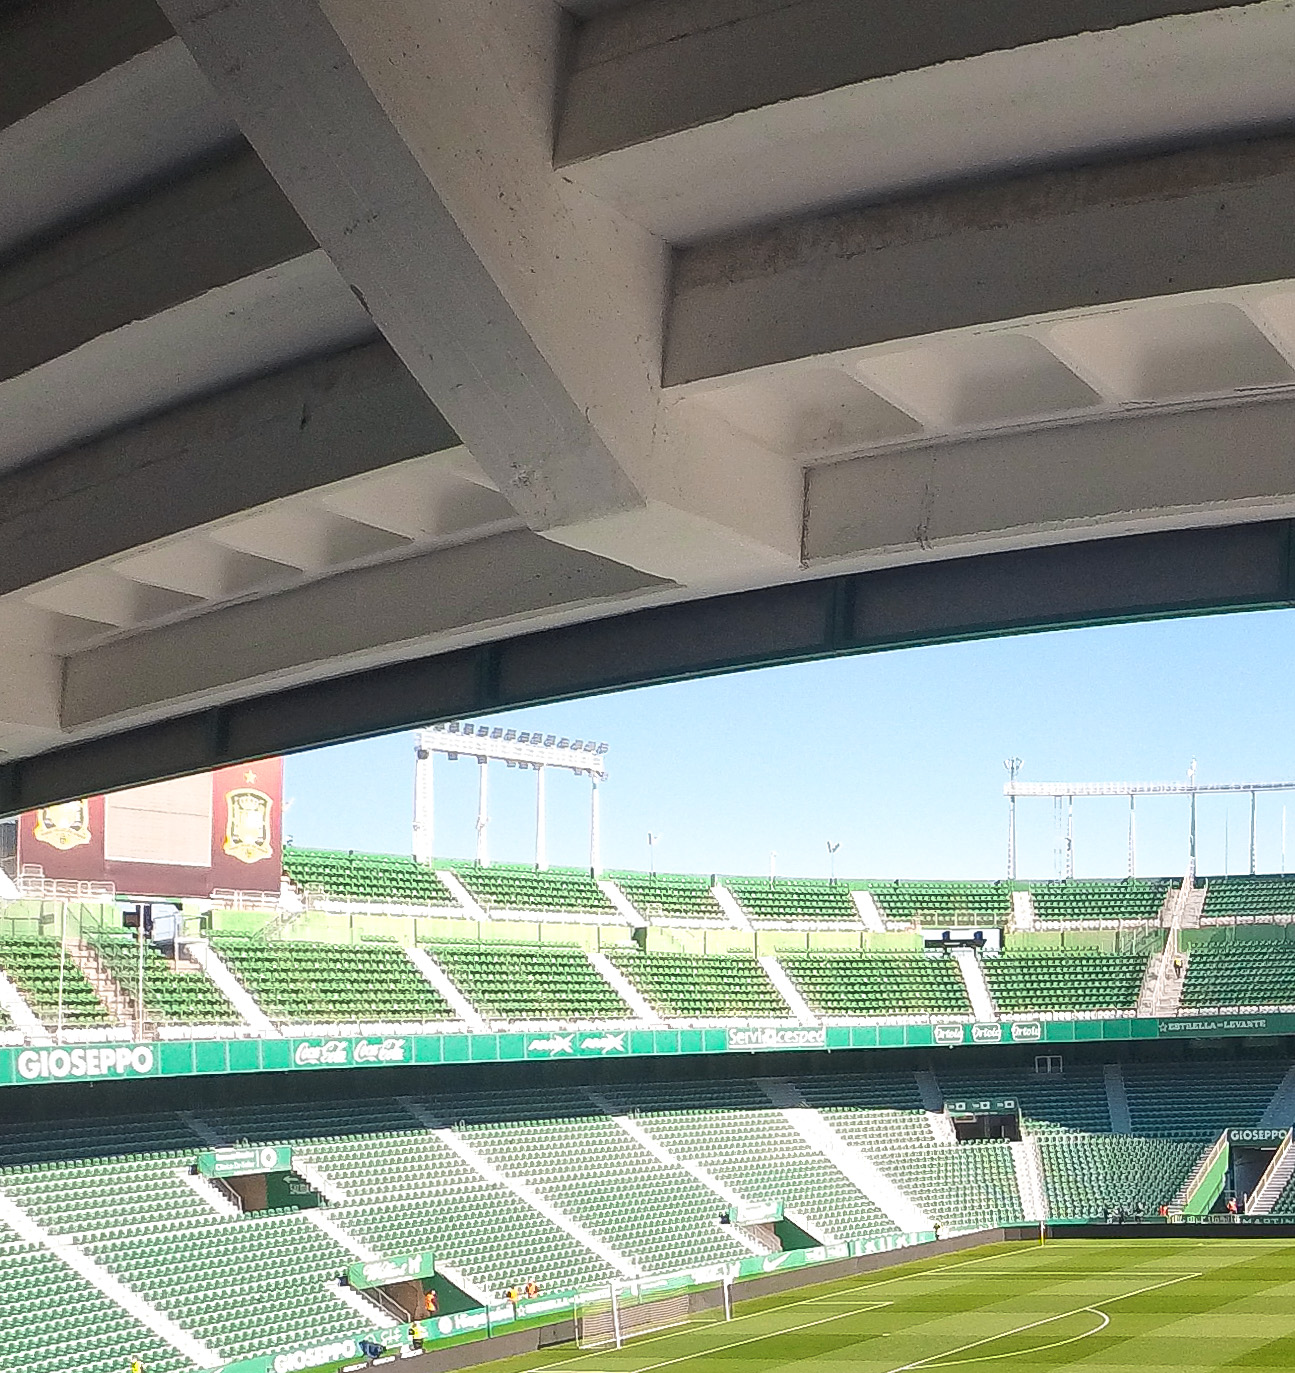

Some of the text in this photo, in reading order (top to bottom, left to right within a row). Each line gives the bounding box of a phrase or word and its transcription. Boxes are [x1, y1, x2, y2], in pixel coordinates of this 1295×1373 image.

[1167, 1021, 1217, 1031] ESTRELLA
[1223, 1019, 1266, 1029] LEVANTE
[17, 1045, 154, 1080] GIOSEPPO
[1230, 1129, 1287, 1141] GIOSEPPO
